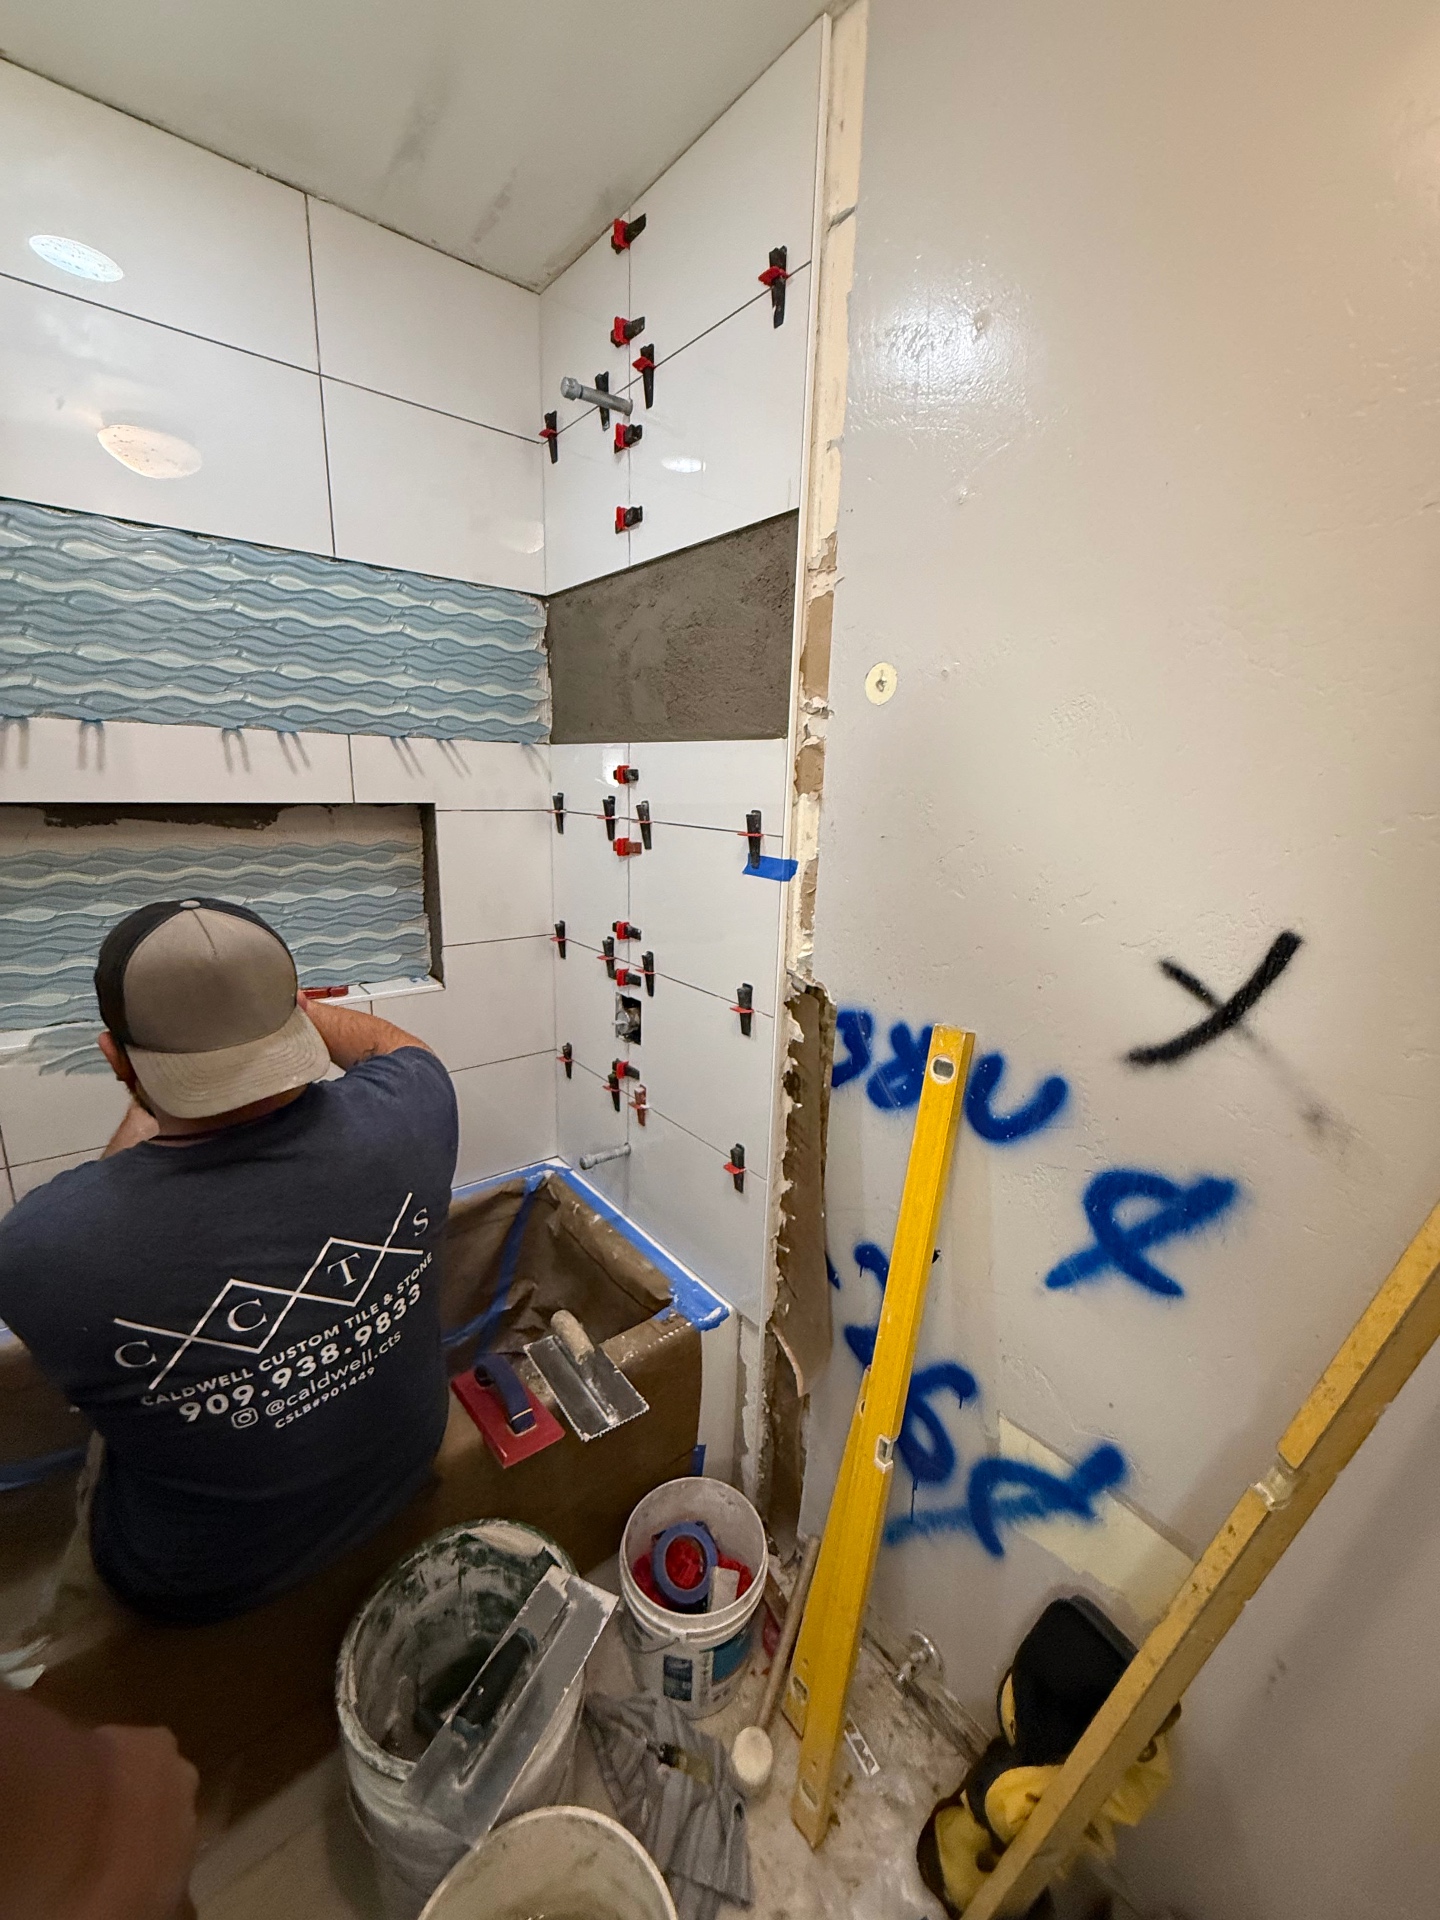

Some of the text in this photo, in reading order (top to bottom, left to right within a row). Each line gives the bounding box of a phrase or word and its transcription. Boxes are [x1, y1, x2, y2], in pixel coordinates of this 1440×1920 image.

[115, 1207, 429, 1368] C C T S
[140, 1252, 434, 1406] CALDWELL CUSTOM TILE & STONE
[179, 1283, 422, 1423] 909.938.9833
[265, 1331, 402, 1417] @caldwell.cts
[274, 1366, 375, 1429] CSLB#901449
